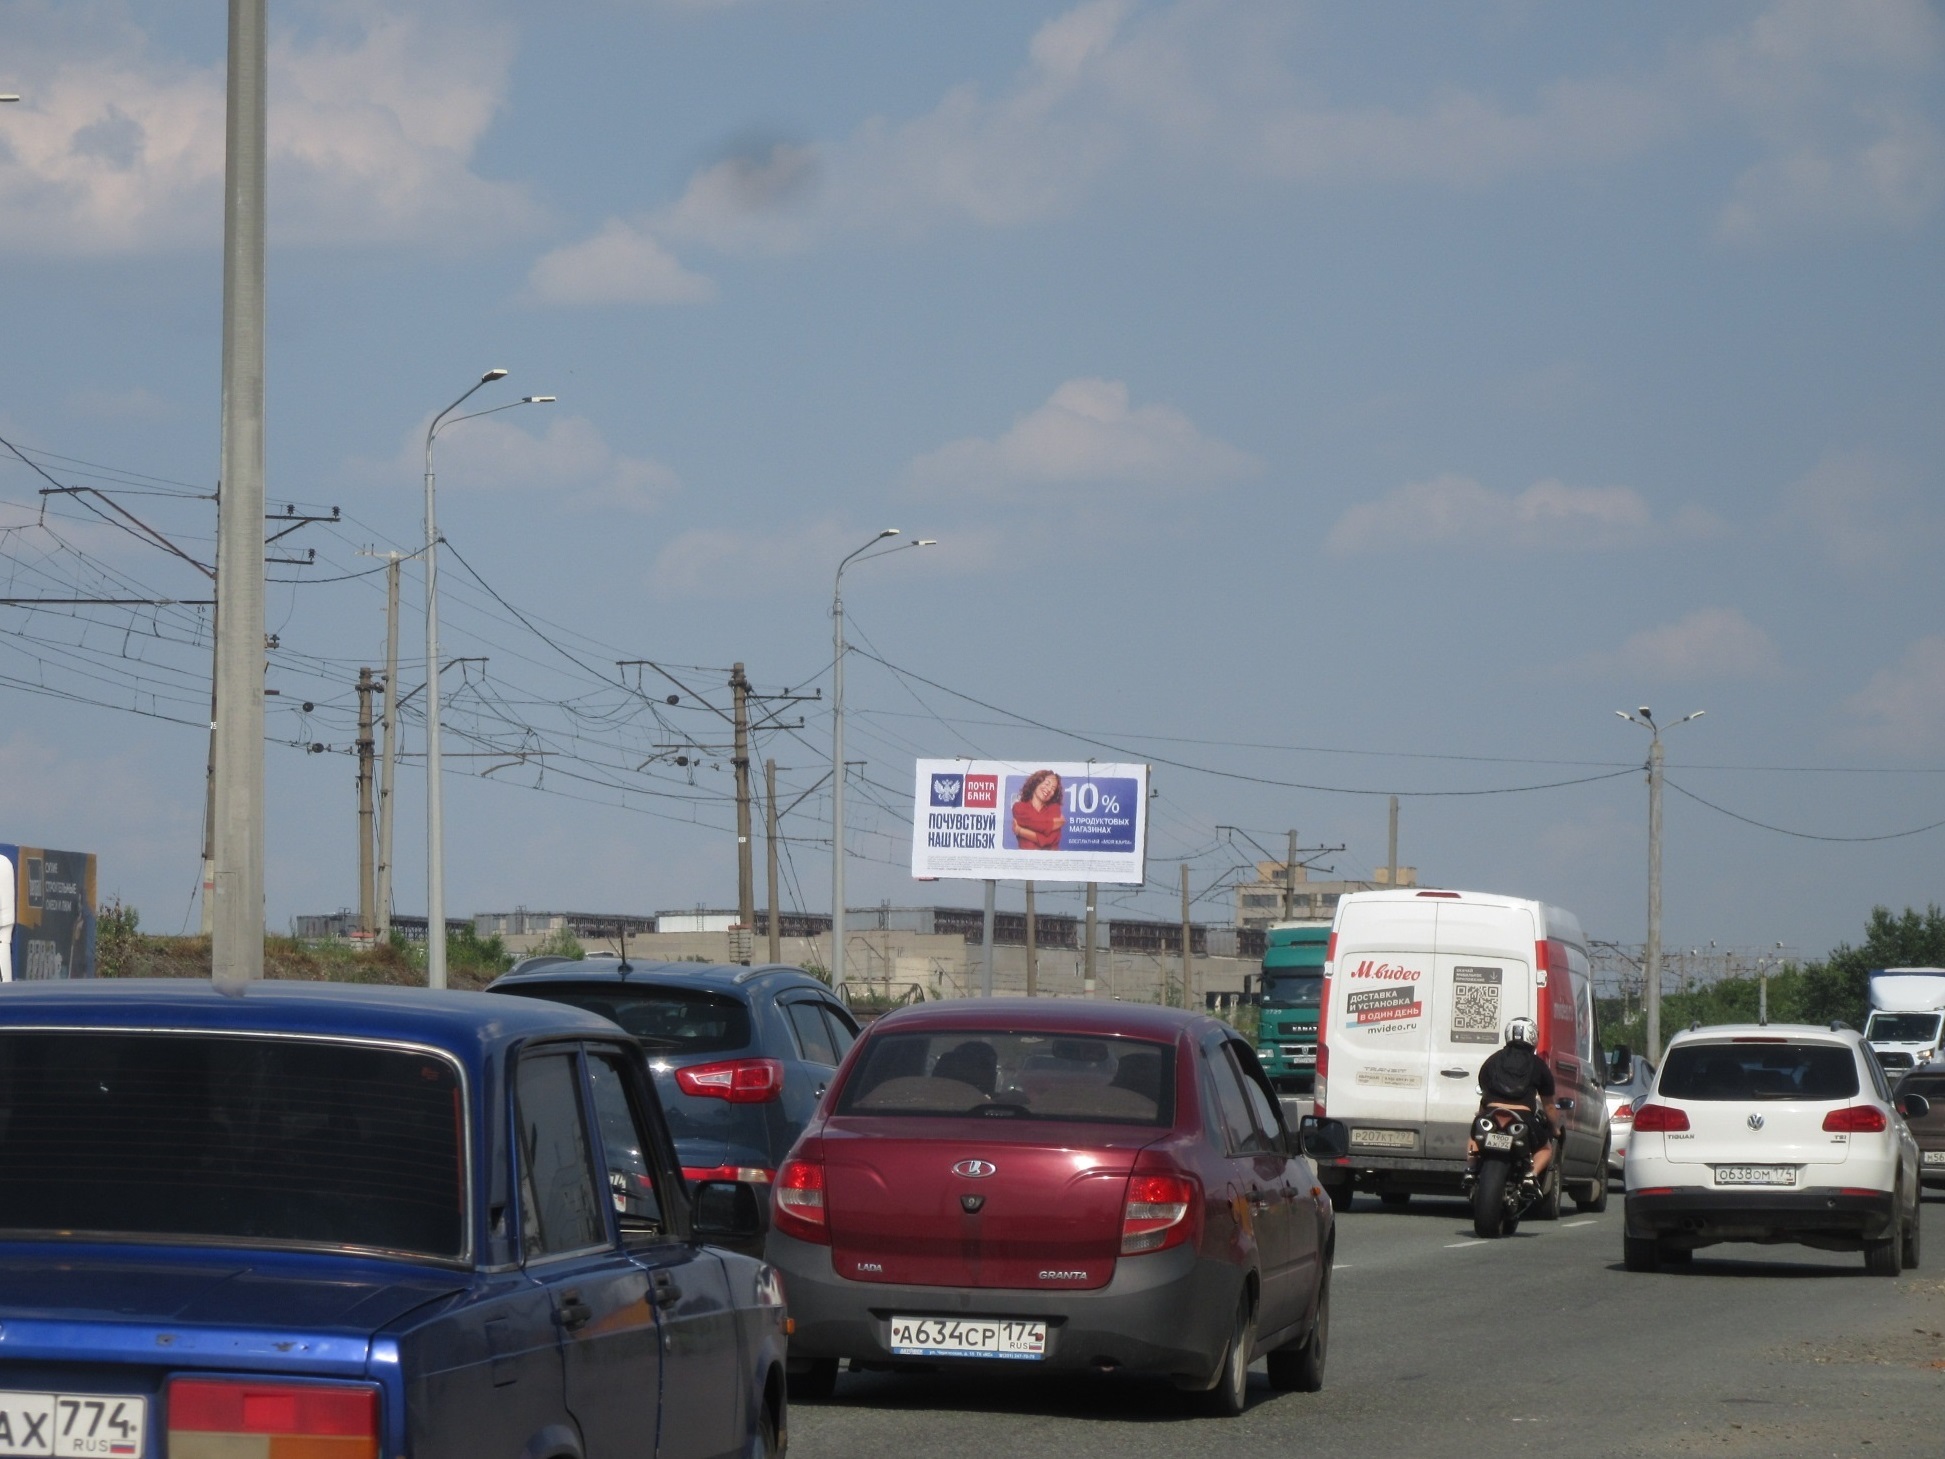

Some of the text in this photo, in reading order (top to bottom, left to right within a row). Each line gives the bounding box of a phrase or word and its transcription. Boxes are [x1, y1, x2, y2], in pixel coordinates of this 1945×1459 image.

[968, 781, 995, 791] ПОЧТА
[968, 791, 992, 801] БАНК
[1064, 782, 1120, 814] 10%
[928, 812, 996, 832] ПОЧУВСТВУЙ
[1076, 817, 1130, 826] ПРОДУКТОВЫХ
[1069, 825, 1112, 834] МАГАЗИНАХ
[928, 831, 996, 849] НАШ КЕШБЭК
[1350, 990, 1398, 1003] ДОСТАВКА
[1358, 998, 1410, 1010] УСТАНОВКА
[1368, 1010, 1394, 1020] ОДИН
[1394, 1008, 1419, 1018] ДЕНЬ
[1368, 1023, 1417, 1034] mvideo.ru
[857, 1262, 883, 1273] LADA
[1038, 1271, 1088, 1280] GRANTA
[899, 1320, 1038, 1347] А634СР 174
[1009, 1342, 1028, 1350] RUS
[59, 1400, 129, 1438] 774
[73, 1439, 108, 1452] RUS
